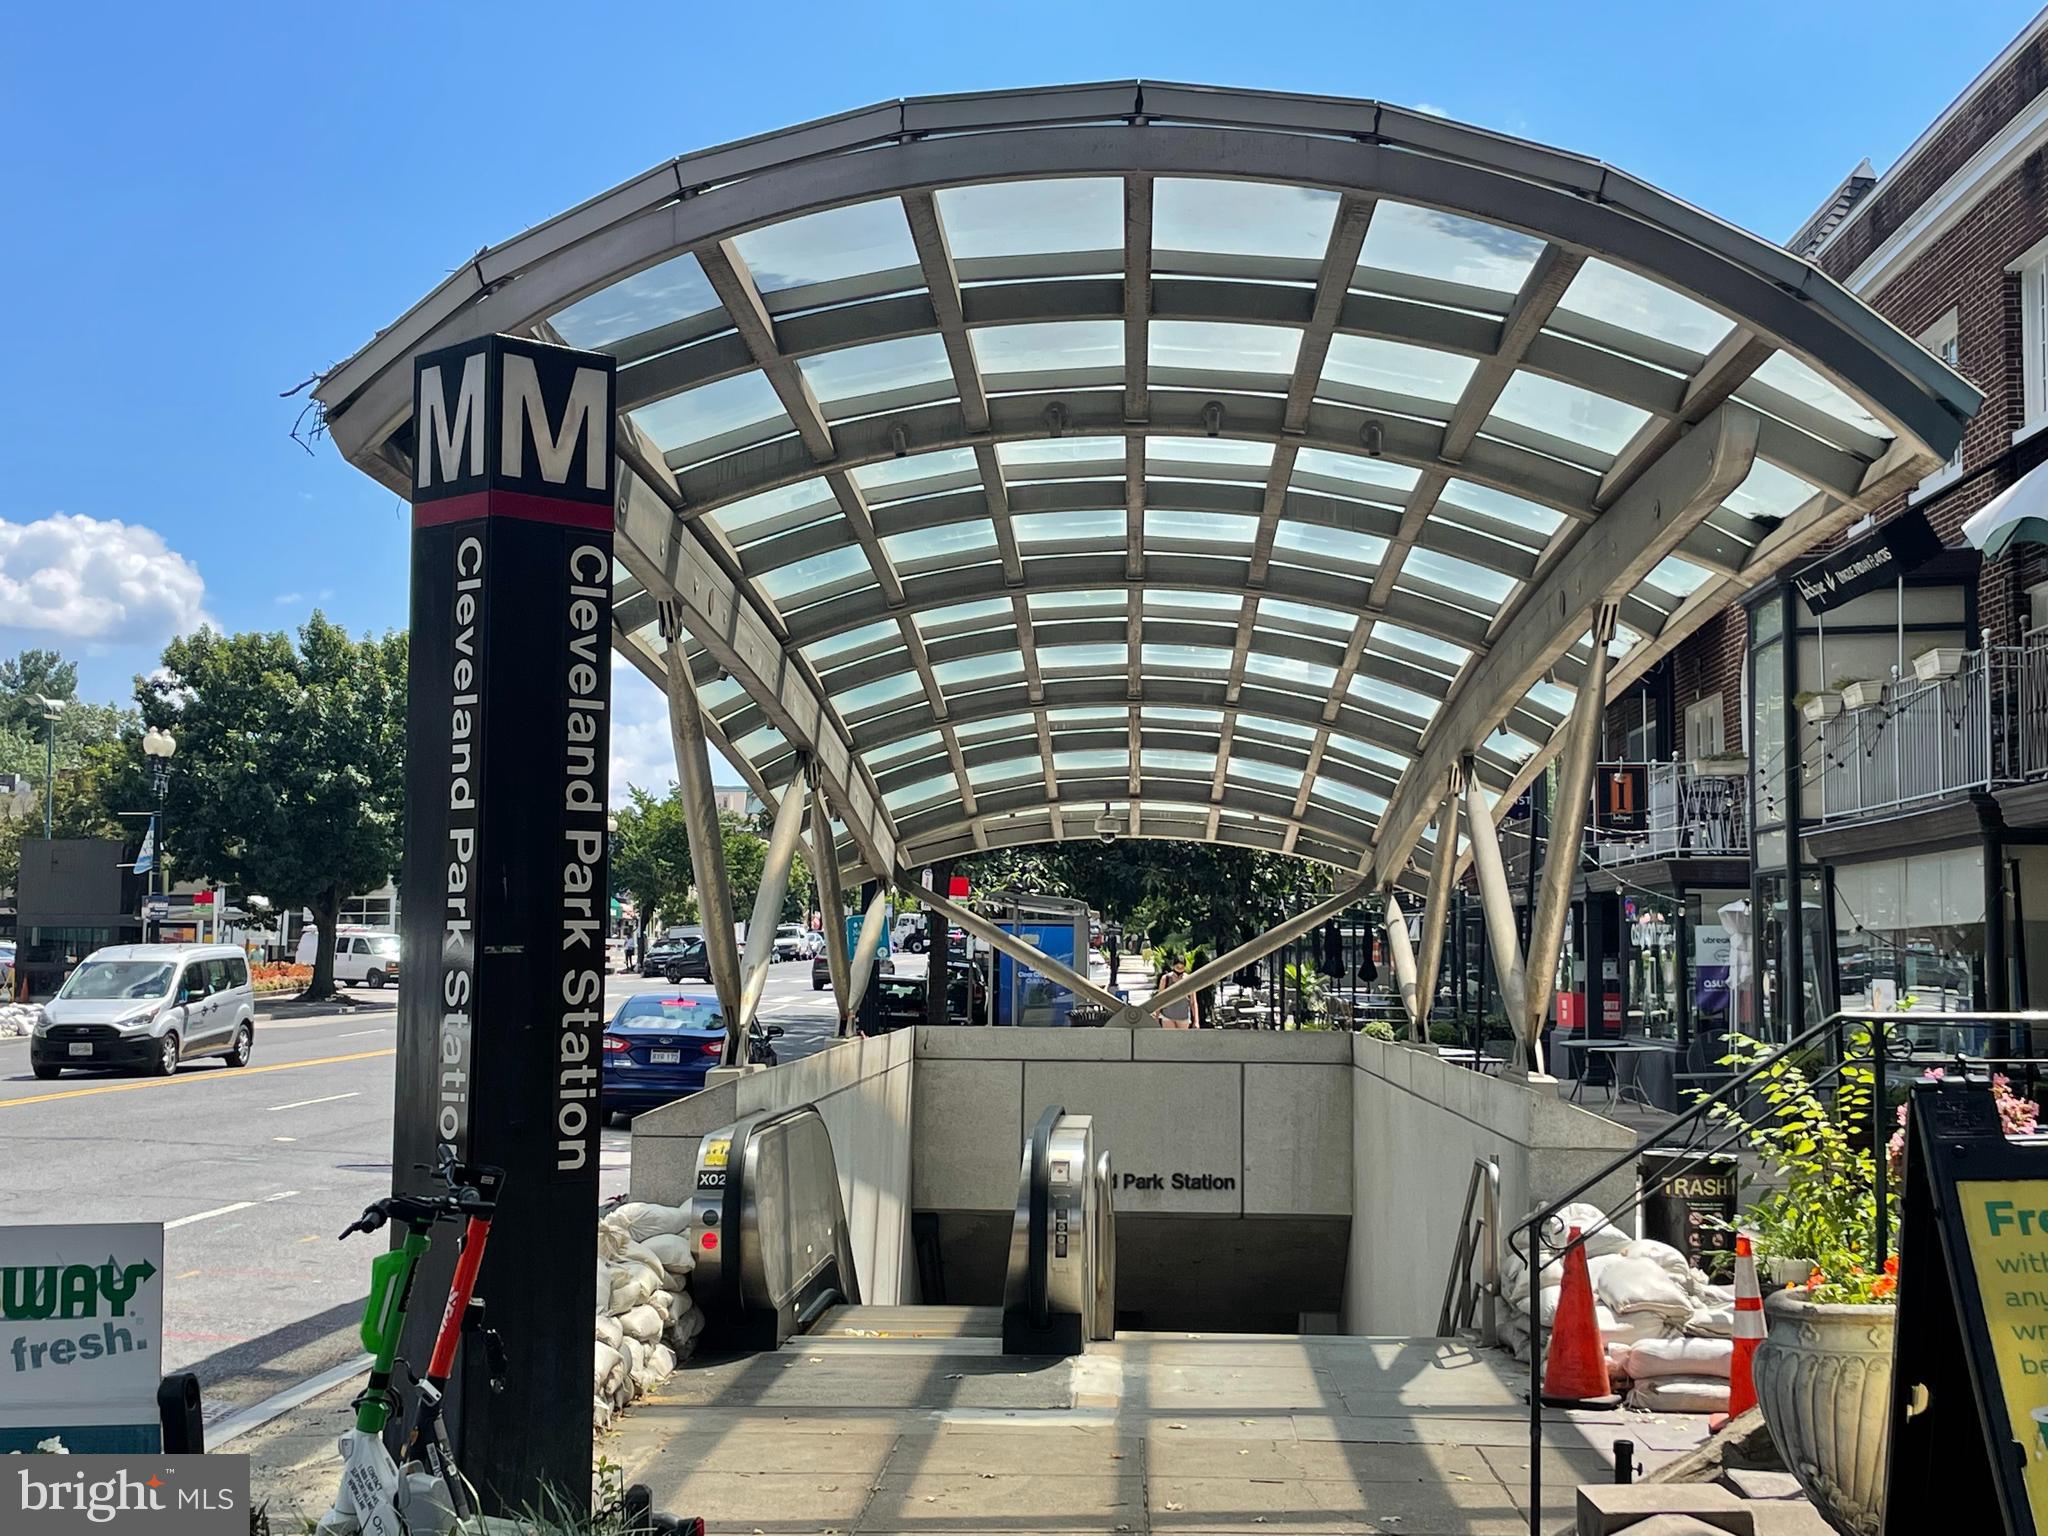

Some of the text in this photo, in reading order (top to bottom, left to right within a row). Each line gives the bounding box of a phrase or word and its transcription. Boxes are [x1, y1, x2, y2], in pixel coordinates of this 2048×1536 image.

[418, 352, 486, 489] M
[501, 352, 608, 491] M
[450, 536, 483, 811] Cleveland
[446, 828, 475, 950] Park
[557, 545, 608, 1171] Cleveland Park Station
[1123, 1173, 1164, 1190] Park
[1171, 1173, 1236, 1190] Station
[1662, 1177, 1727, 1197] TRASH
[1996, 1252, 2048, 1274] wit
